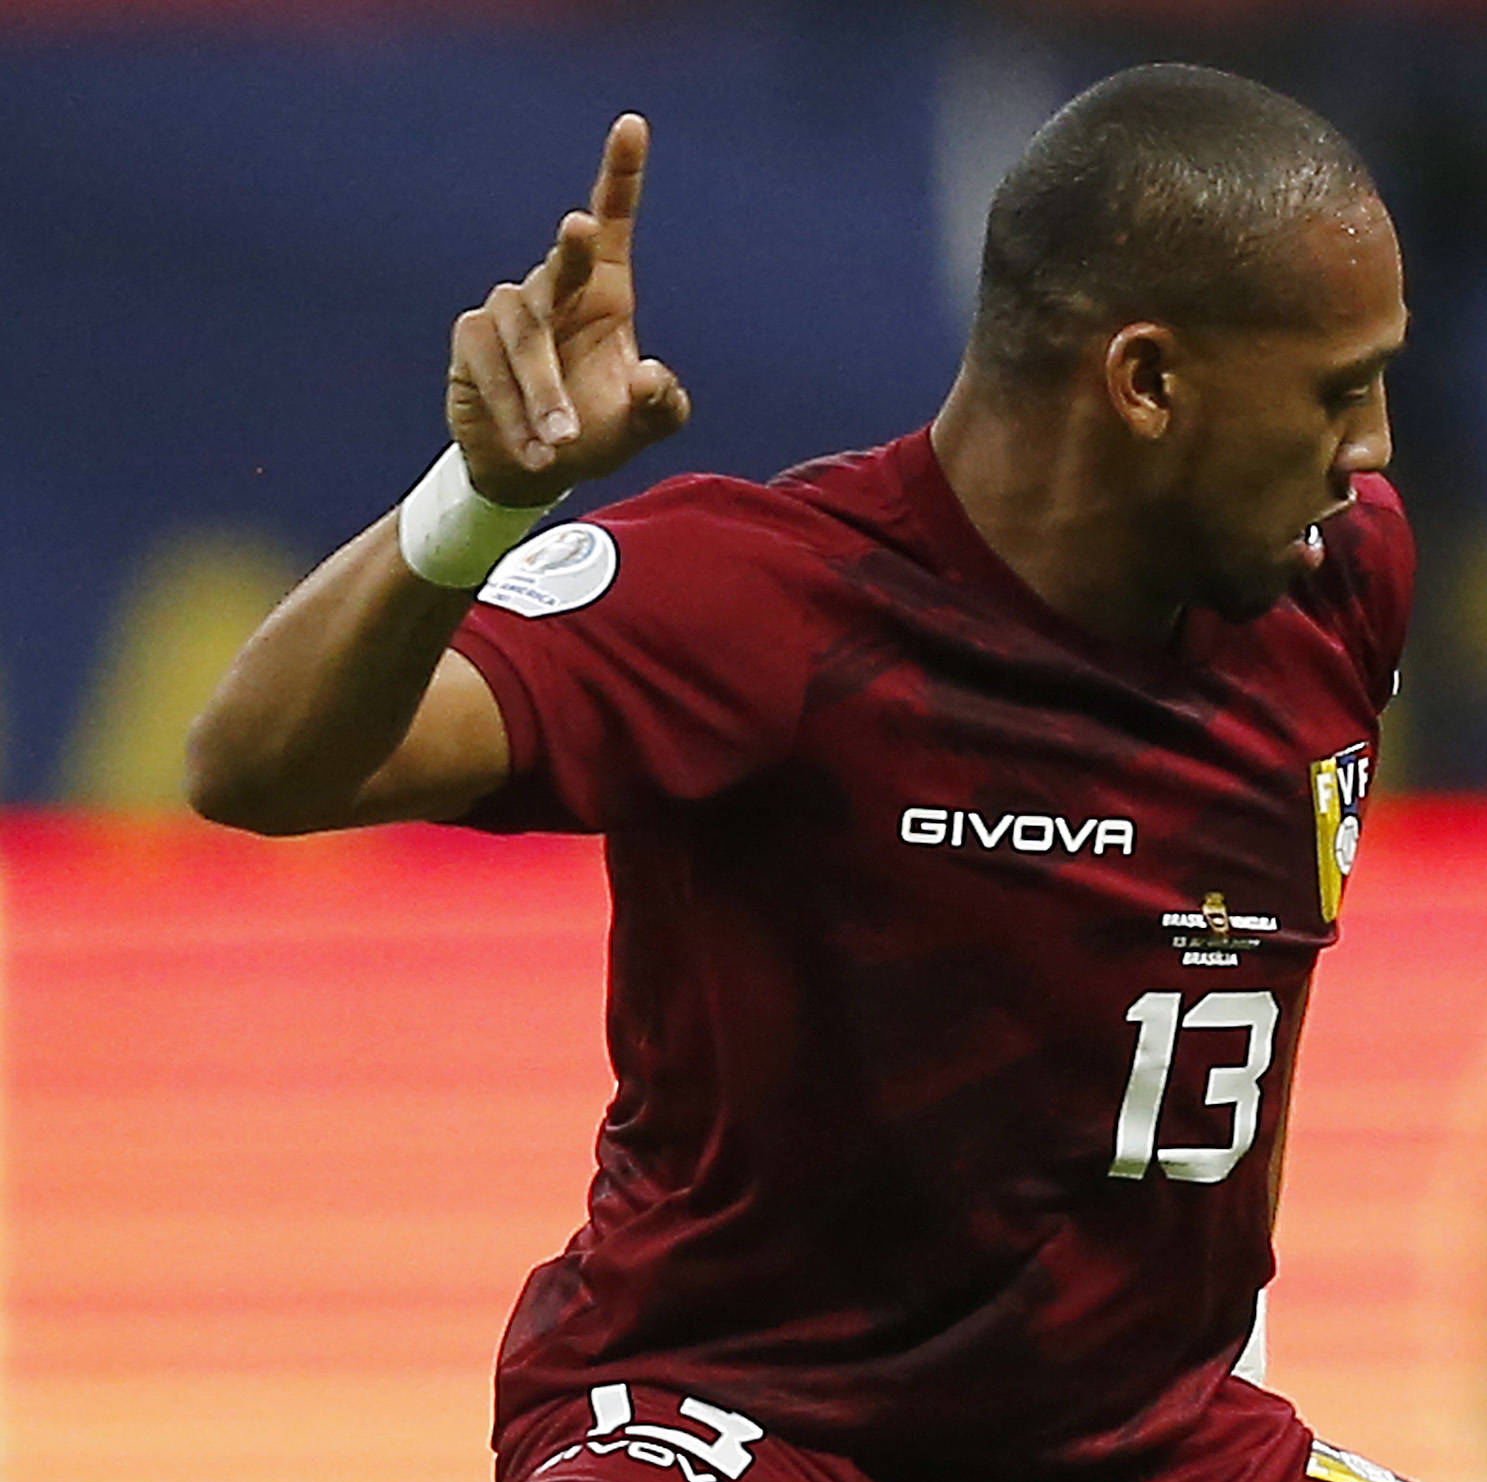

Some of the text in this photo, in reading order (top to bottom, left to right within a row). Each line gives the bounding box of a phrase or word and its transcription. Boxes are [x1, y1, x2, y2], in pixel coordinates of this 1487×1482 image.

[1316, 756, 1370, 815] FVF
[901, 807, 1135, 856] GIVOVA
[1107, 992, 1280, 1184] 13
